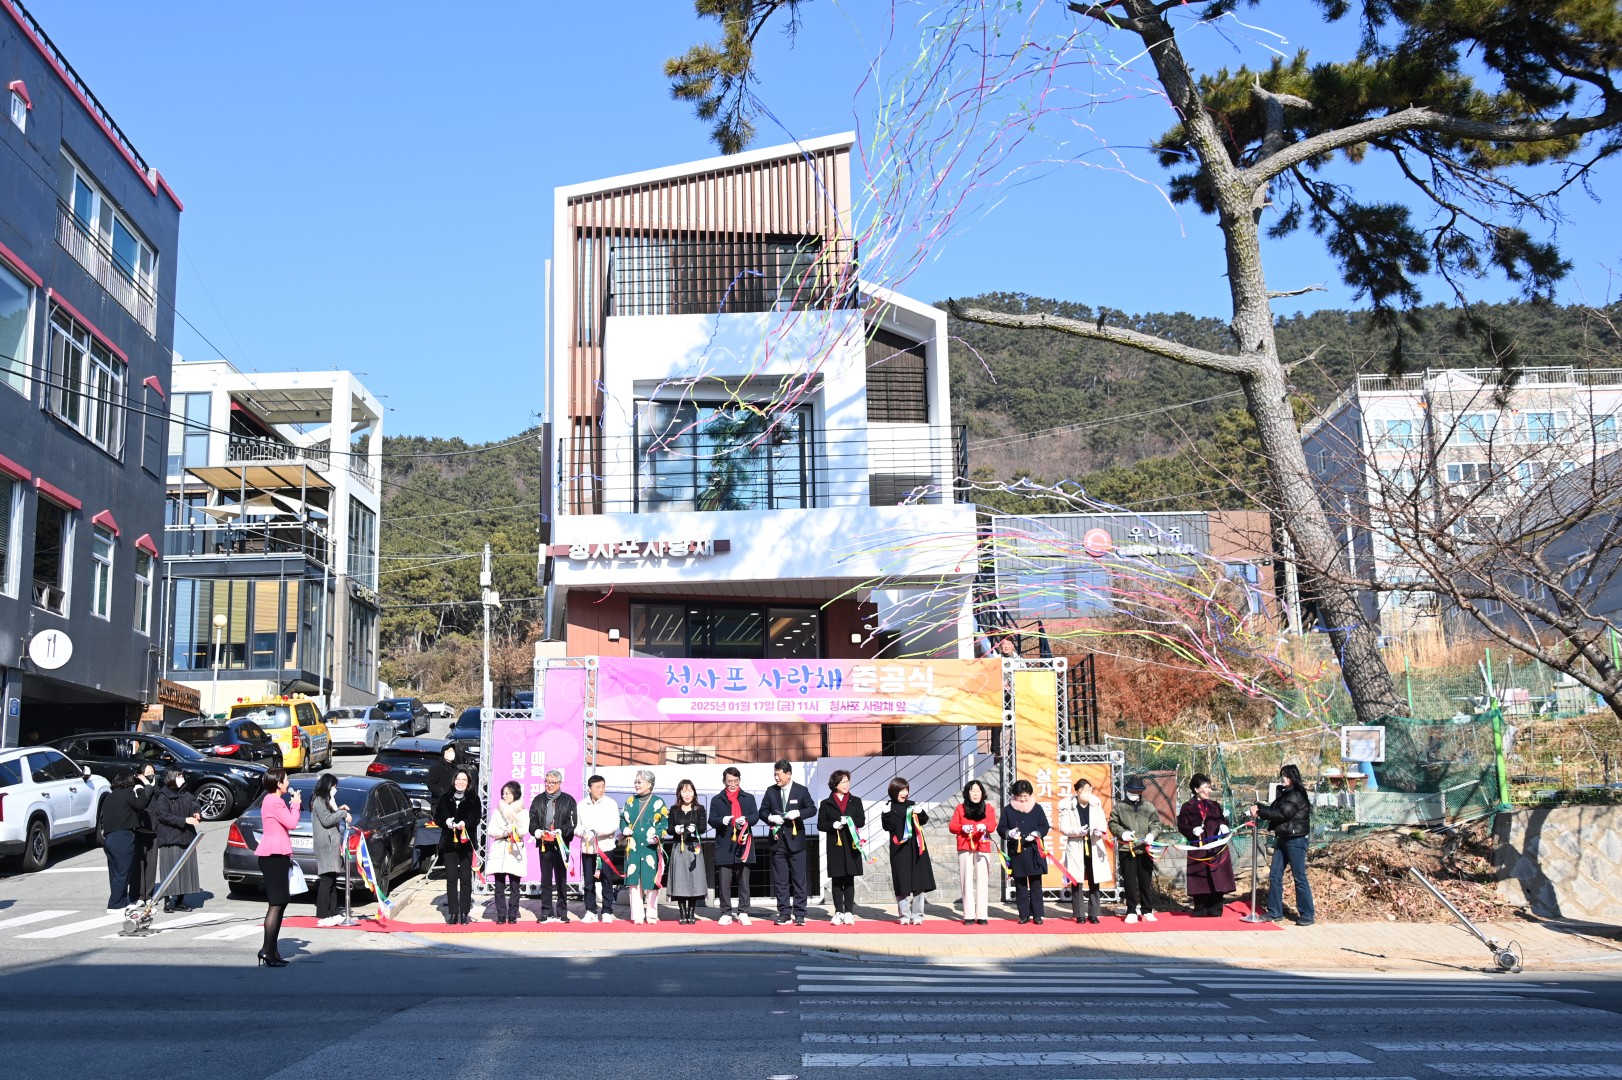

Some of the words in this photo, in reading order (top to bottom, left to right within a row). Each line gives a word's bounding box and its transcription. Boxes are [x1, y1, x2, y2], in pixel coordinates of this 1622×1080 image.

[568, 538, 715, 560] 청사포사랑채
[665, 664, 748, 695] 청사포
[758, 664, 842, 695] 사랑채
[851, 666, 934, 694] 준공식
[690, 701, 726, 712] 2025년
[728, 701, 751, 712] 01월
[753, 701, 775, 712] 17일
[797, 701, 819, 712] 11시
[829, 701, 860, 712] 청사포
[862, 701, 894, 712] 사랑채
[511, 751, 526, 779] 일상
[530, 751, 546, 779] 매력
[1036, 768, 1052, 797] 살기
[1056, 768, 1073, 797] 오고
